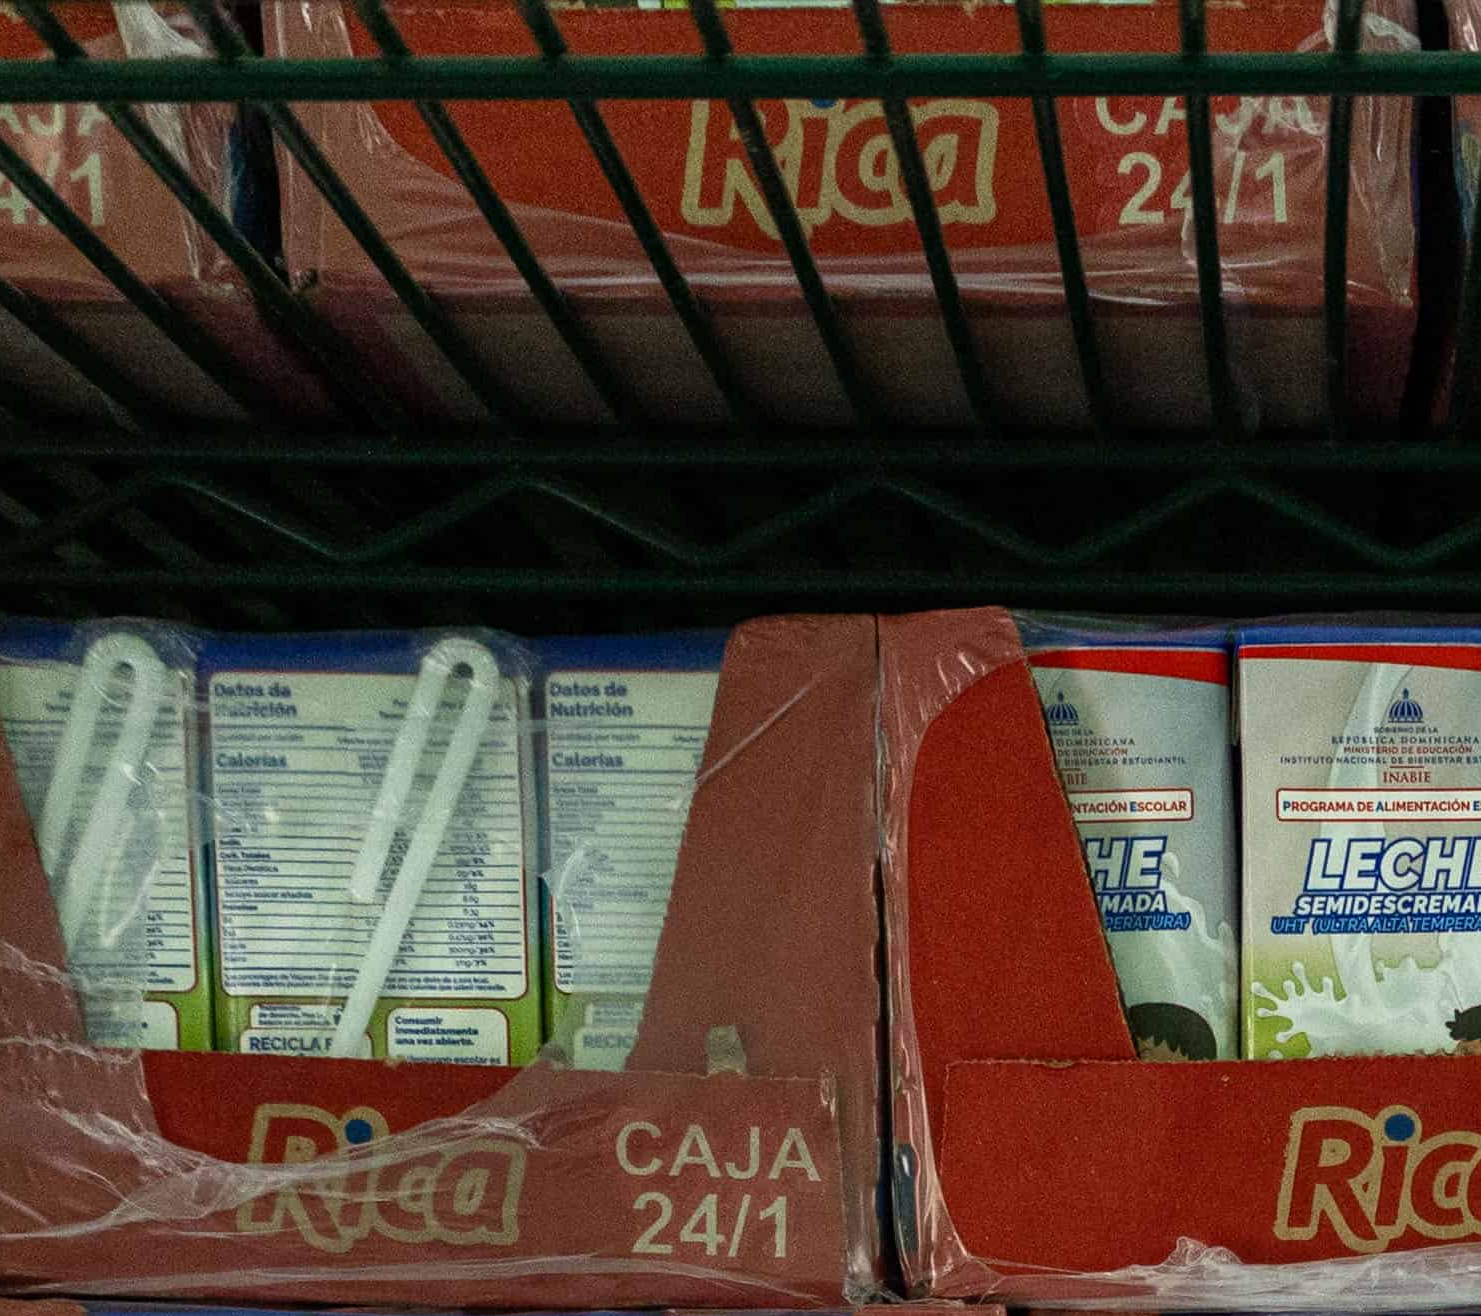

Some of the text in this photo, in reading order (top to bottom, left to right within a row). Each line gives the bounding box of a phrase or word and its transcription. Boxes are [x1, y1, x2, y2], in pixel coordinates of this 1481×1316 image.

[1383, 772, 1431, 783] INABIE
[1283, 800, 1354, 812] PROGRAMA
[1357, 801, 1373, 812] DE
[1376, 798, 1470, 812] ALIMENTACIÓN
[1271, 917, 1304, 934] UHT
[1313, 916, 1372, 933] (ULTRA
[1369, 916, 1412, 933] ALTA
[615, 1121, 822, 1182] CAJA
[237, 1104, 528, 1252] Rica
[630, 1192, 789, 1257] 24/1
